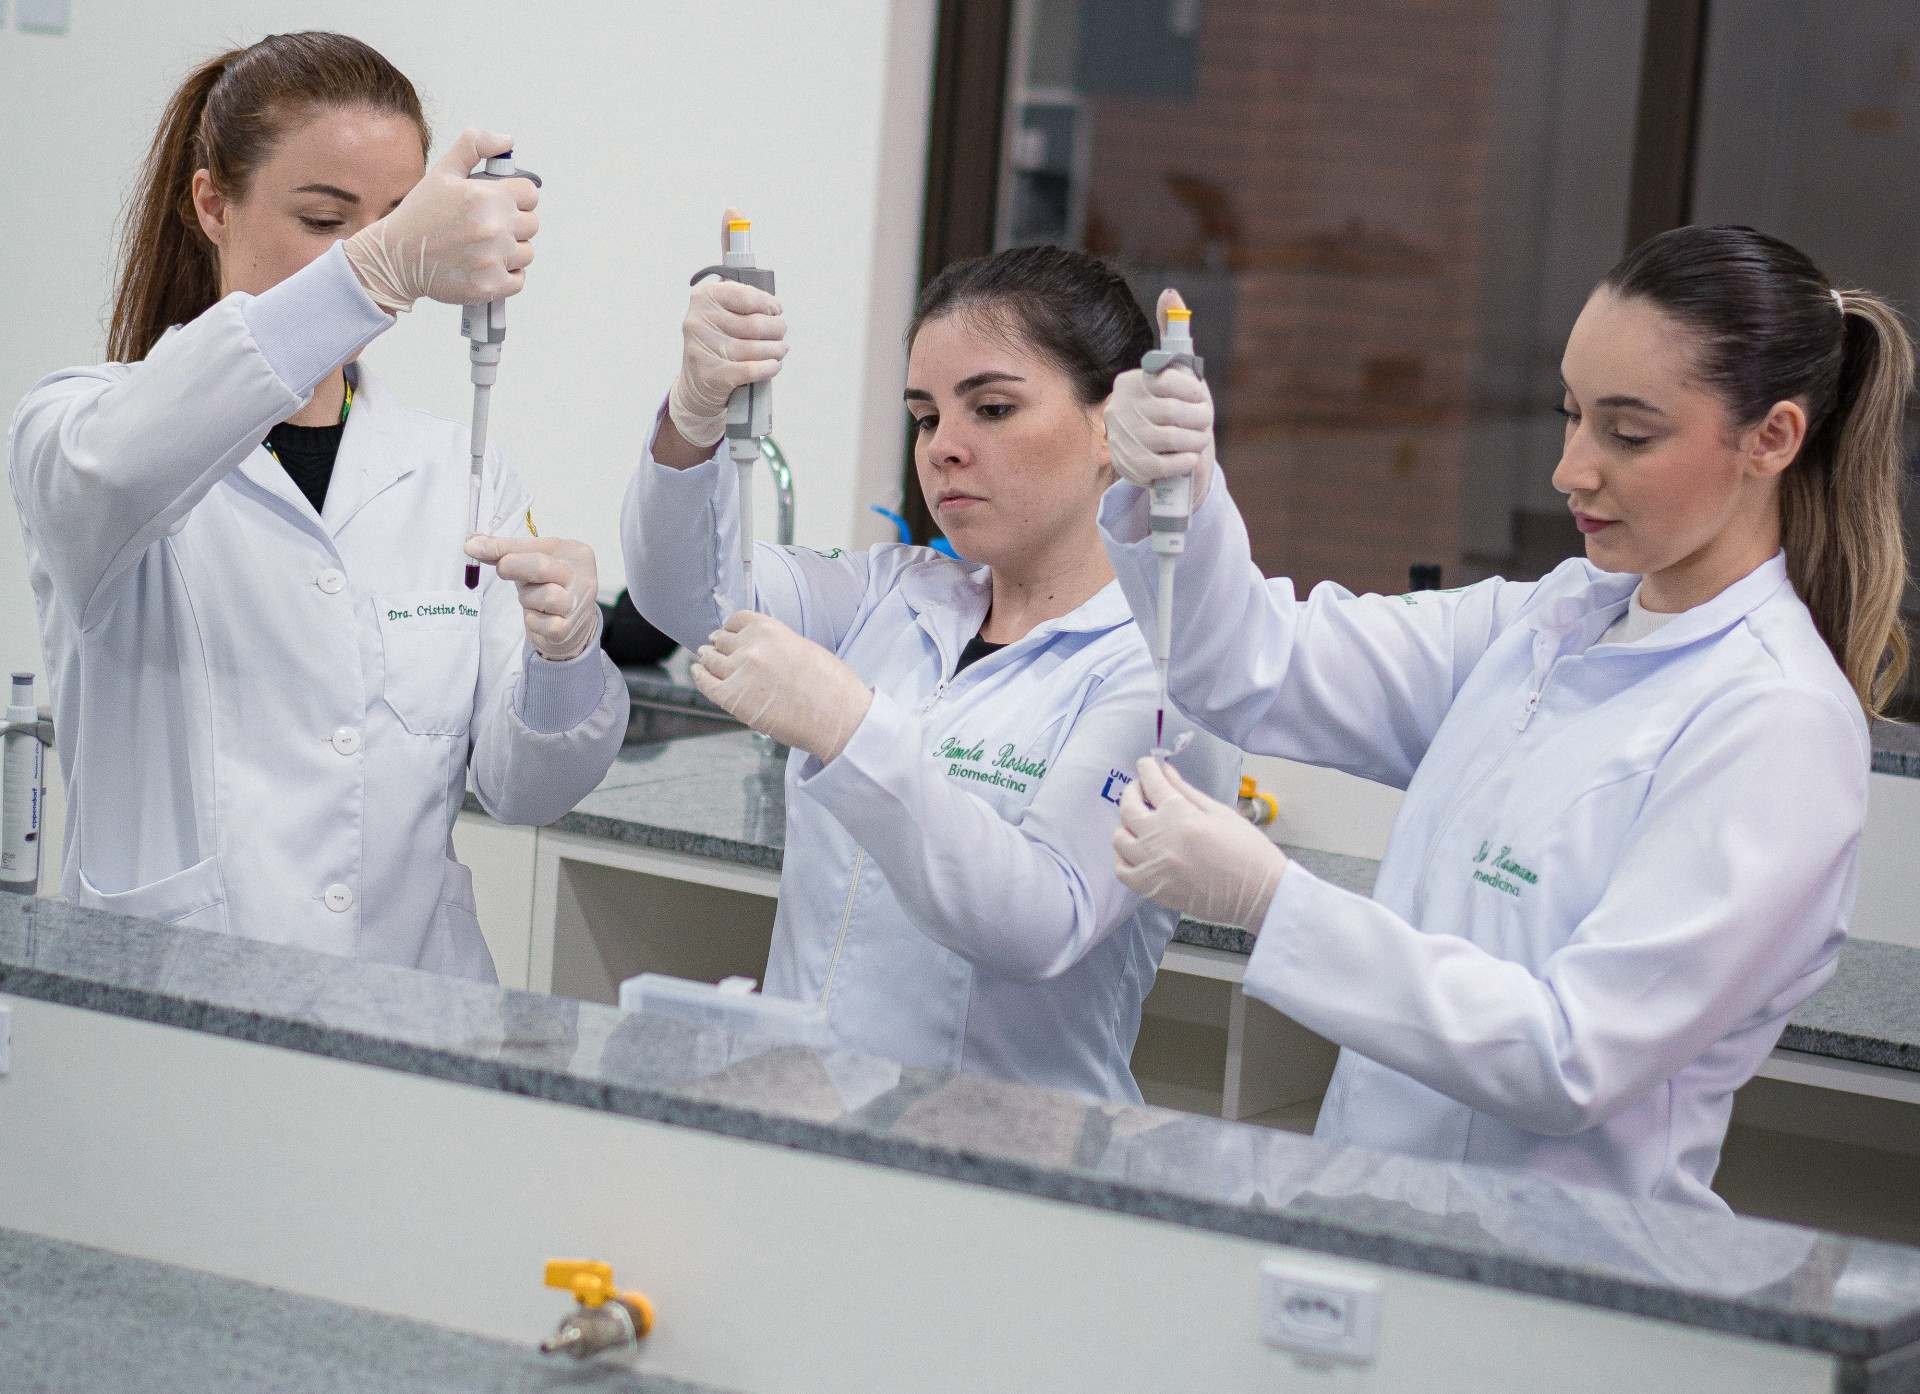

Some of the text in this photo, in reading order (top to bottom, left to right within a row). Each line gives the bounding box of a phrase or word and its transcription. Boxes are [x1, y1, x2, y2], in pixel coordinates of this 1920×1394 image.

[387, 609, 413, 621] Dra.
[416, 603, 456, 617] Cristine
[947, 763, 1028, 794] Biomedicina
[1472, 870, 1521, 898] medicina
